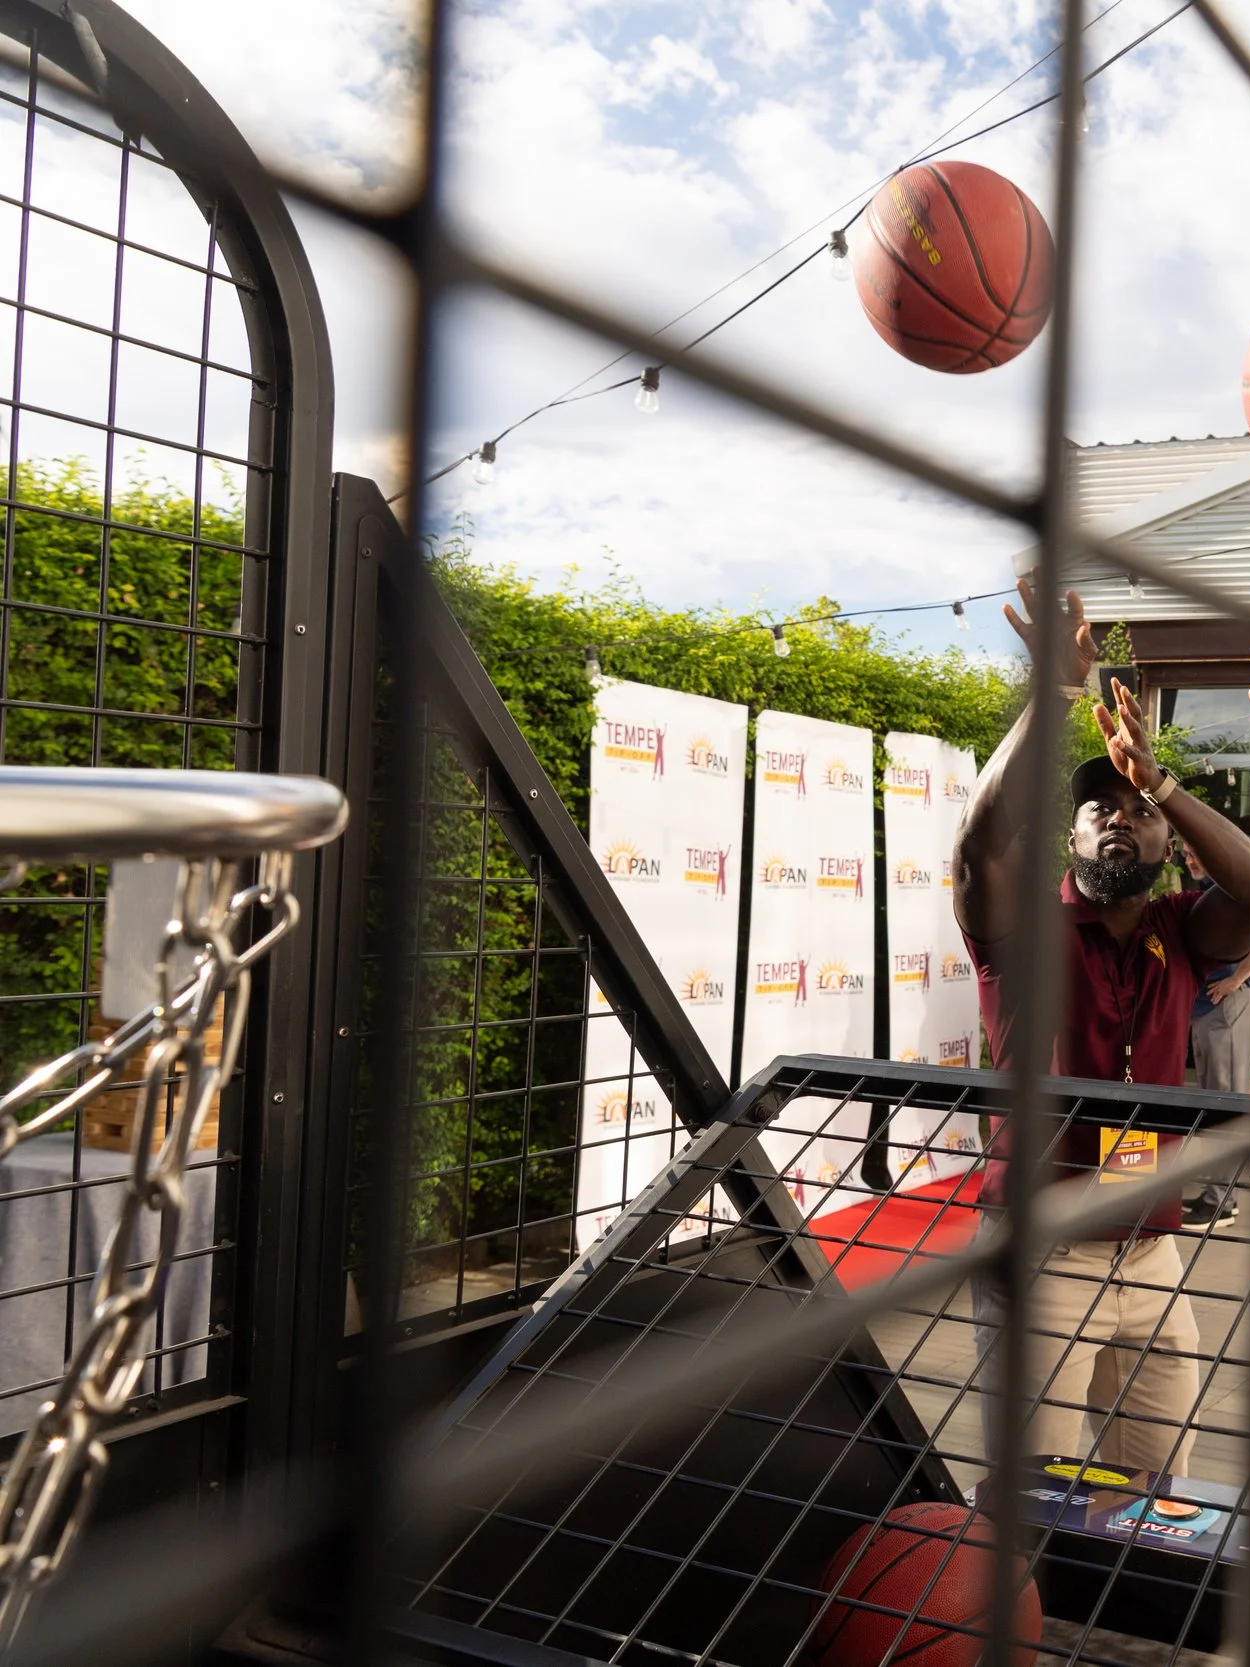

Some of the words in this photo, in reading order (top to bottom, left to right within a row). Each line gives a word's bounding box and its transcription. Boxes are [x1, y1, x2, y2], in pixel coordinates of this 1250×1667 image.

[605, 721, 655, 750] TEMPE
[766, 750, 799, 773] TEMPE
[891, 767, 925, 786] TEMPE
[686, 848, 718, 871] TEMPE
[819, 857, 856, 877] TEMPE
[756, 962, 797, 982] TEMPE
[894, 953, 925, 972] TEMPE
[939, 1040, 965, 1058] TEMPE
[1120, 1153, 1142, 1165] VIP
